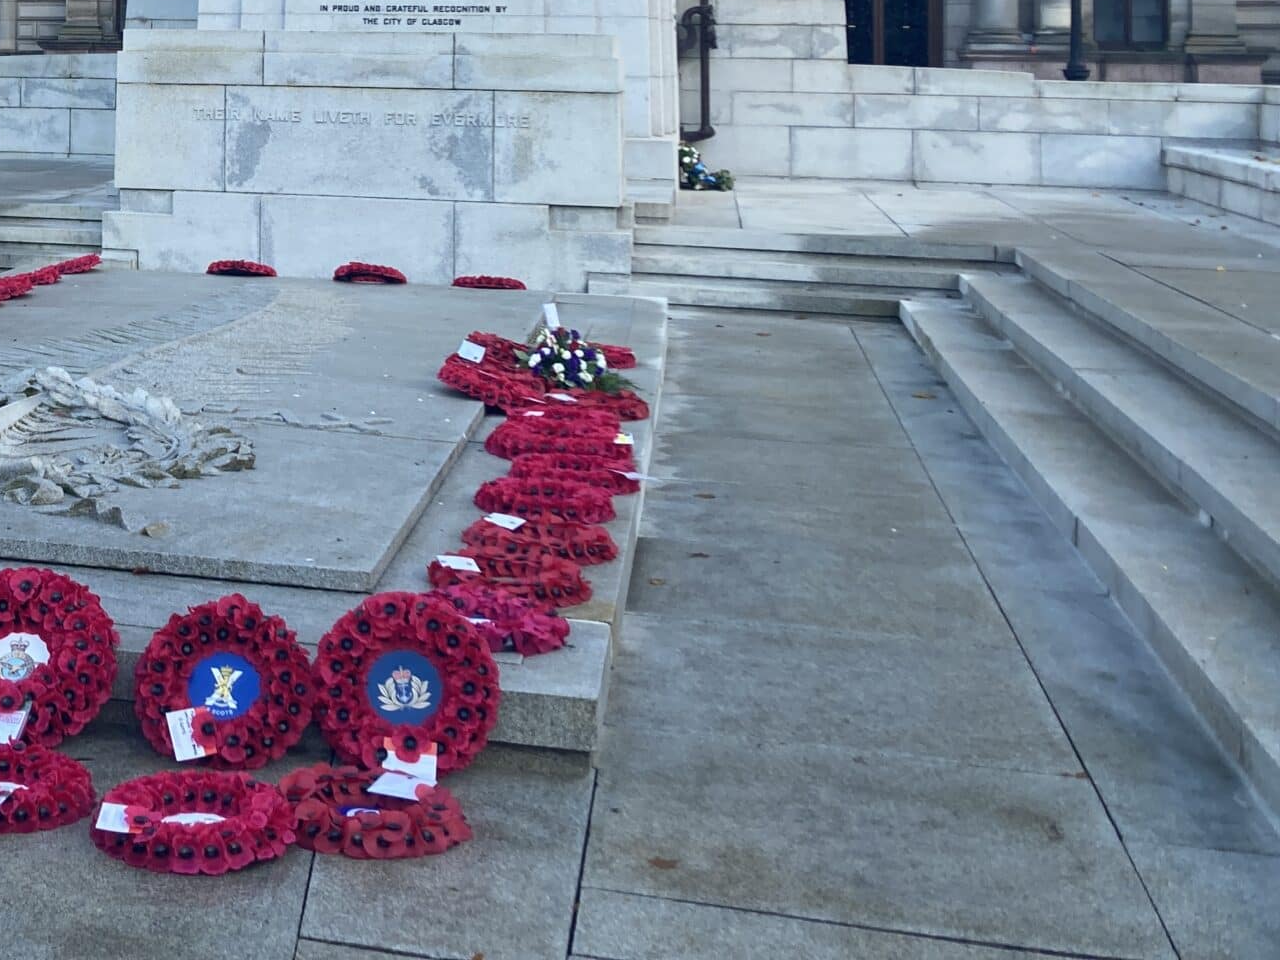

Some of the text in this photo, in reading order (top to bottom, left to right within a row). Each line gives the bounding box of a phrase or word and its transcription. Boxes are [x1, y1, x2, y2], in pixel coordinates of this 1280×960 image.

[320, 4, 507, 14] IN PROUD AND GRATEFUL RECOGNITION BY
[363, 17, 461, 26] THE CITY OF GLASGOW
[191, 106, 530, 129] THEIR NAME LIVETH FOR EVERMORE
